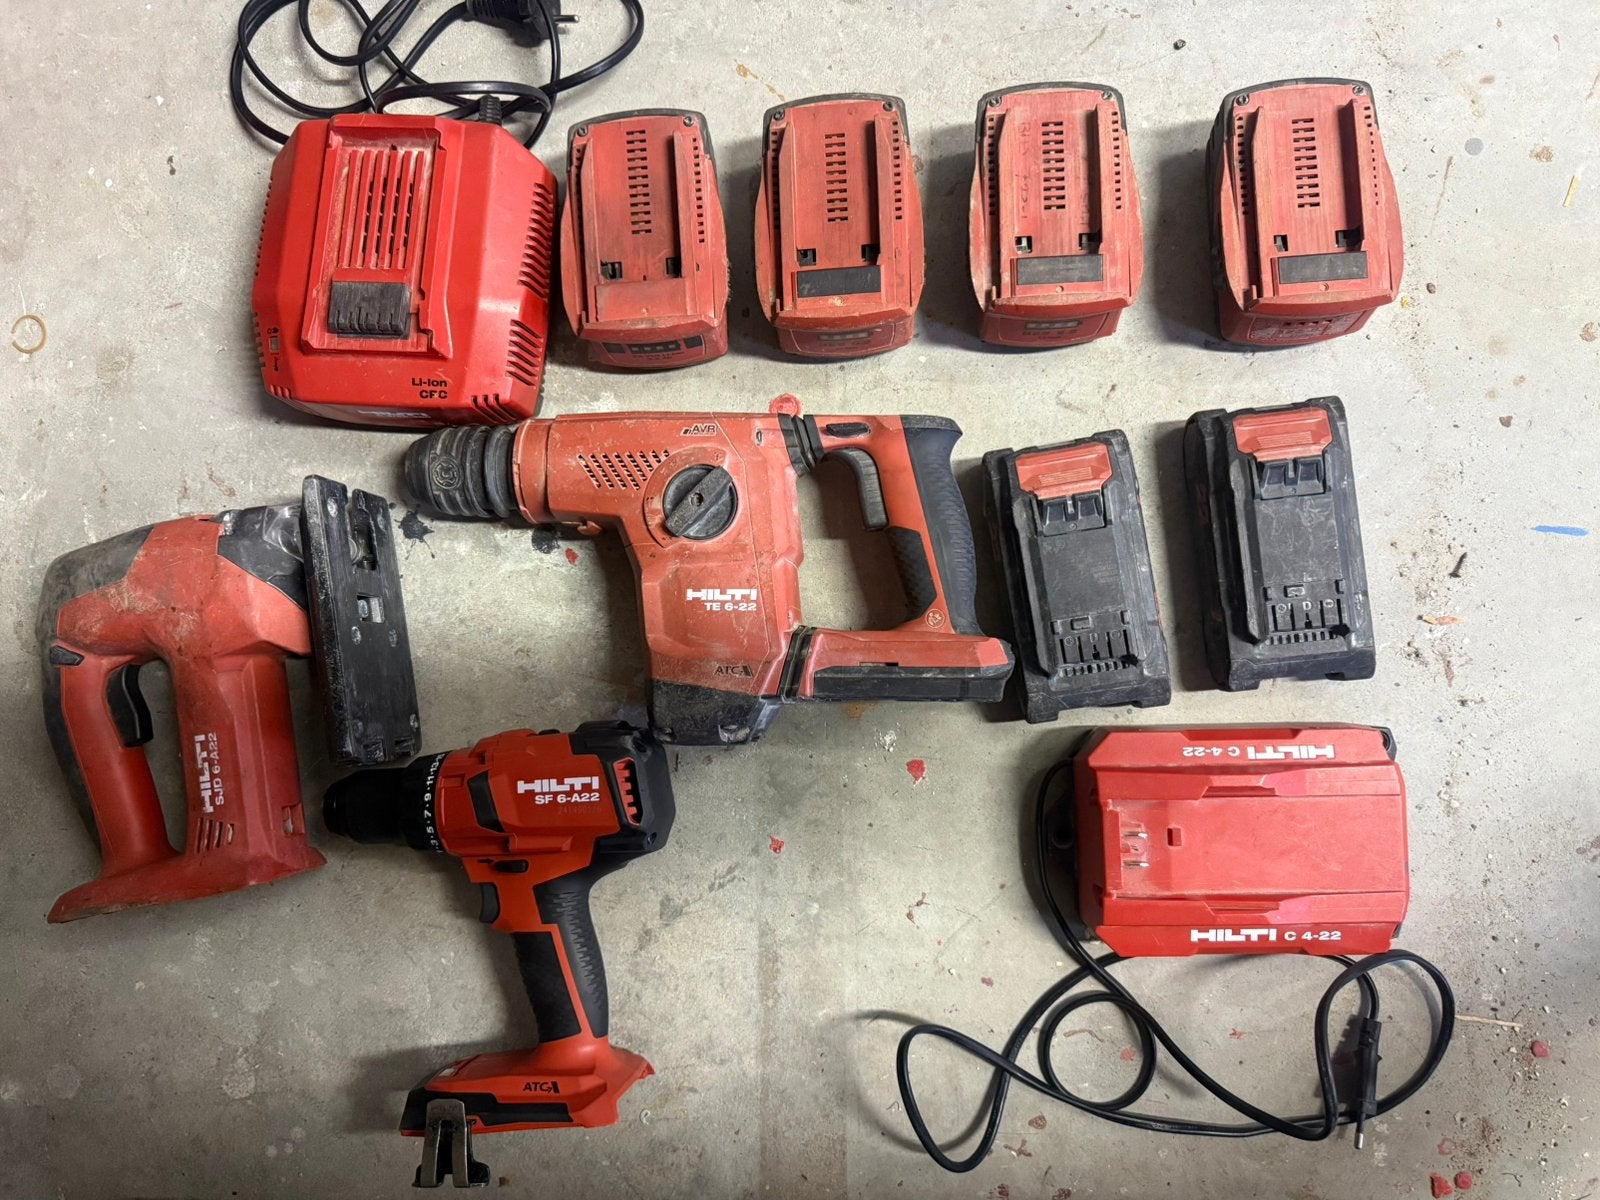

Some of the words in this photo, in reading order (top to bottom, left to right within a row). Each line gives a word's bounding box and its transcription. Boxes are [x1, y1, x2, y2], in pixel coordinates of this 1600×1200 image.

[411, 377, 448, 388] Li-Ion
[419, 389, 448, 400] CFC
[692, 424, 716, 433] AVR
[686, 588, 758, 601] HILTI
[704, 602, 721, 611] TE
[724, 602, 757, 611] 6-22
[714, 664, 743, 676] ATC
[208, 732, 221, 775] 6-A22
[1182, 746, 1223, 757] 4-22
[1227, 746, 1241, 757] C
[1247, 744, 1335, 760] HILTI
[194, 734, 214, 813] HILTI
[426, 775, 435, 786] 11
[517, 776, 600, 794] HILTI
[213, 777, 225, 806] SJD
[424, 792, 432, 801] 9
[535, 794, 554, 805] SF
[556, 792, 600, 804] 6-A22
[424, 809, 432, 818] 7
[426, 826, 434, 834] 5
[1190, 928, 1277, 942] HILTI
[1284, 931, 1297, 941] C
[1301, 930, 1342, 941] 4-22
[522, 1081, 552, 1093] ATC
